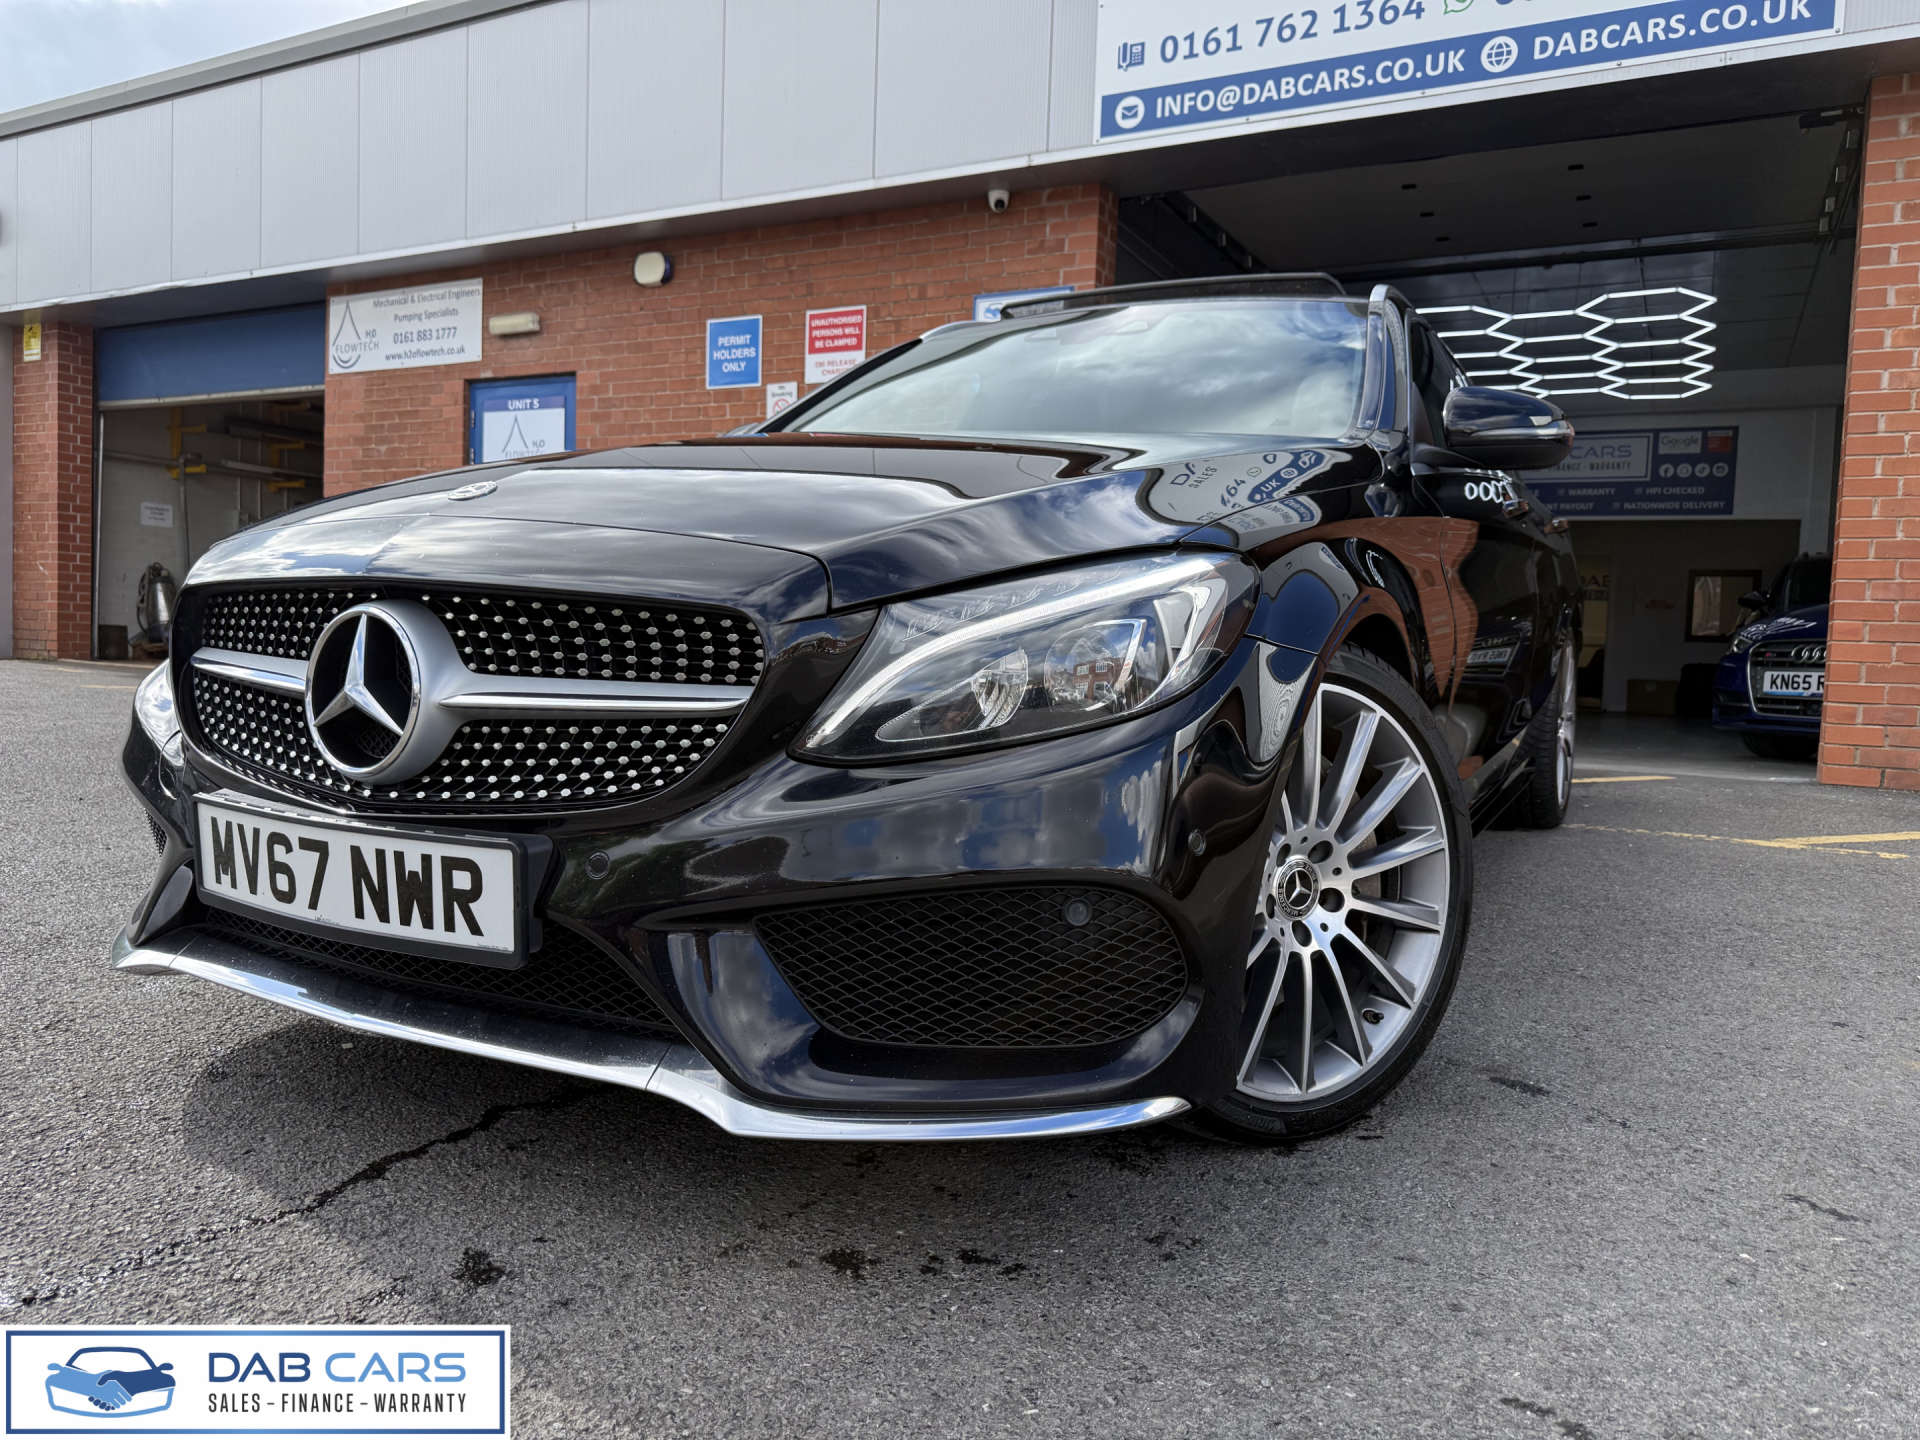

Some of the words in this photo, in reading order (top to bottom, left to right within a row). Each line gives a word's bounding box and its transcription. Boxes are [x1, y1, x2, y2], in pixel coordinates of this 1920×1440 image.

[1160, 23, 1243, 64] 0161
[1255, 9, 1319, 48] 762
[1333, 0, 1425, 34] 1364
[1533, 0, 1813, 60] DABCARS.CO.UK
[1156, 49, 1466, 119] INFO@DABCARS.CO.UK
[393, 312, 423, 322] Pumping
[393, 331, 415, 344] 0161
[417, 328, 433, 341] 883
[435, 326, 457, 340] 1777
[718, 334, 752, 347] PERMIT
[335, 341, 380, 354] FLOWTECH
[713, 347, 756, 360] HOLDERS
[722, 361, 746, 373] ONLY
[508, 399, 532, 410] UNIT
[1769, 673, 1813, 690] KN65
[211, 816, 329, 911] MV67
[350, 844, 485, 937] NWR
